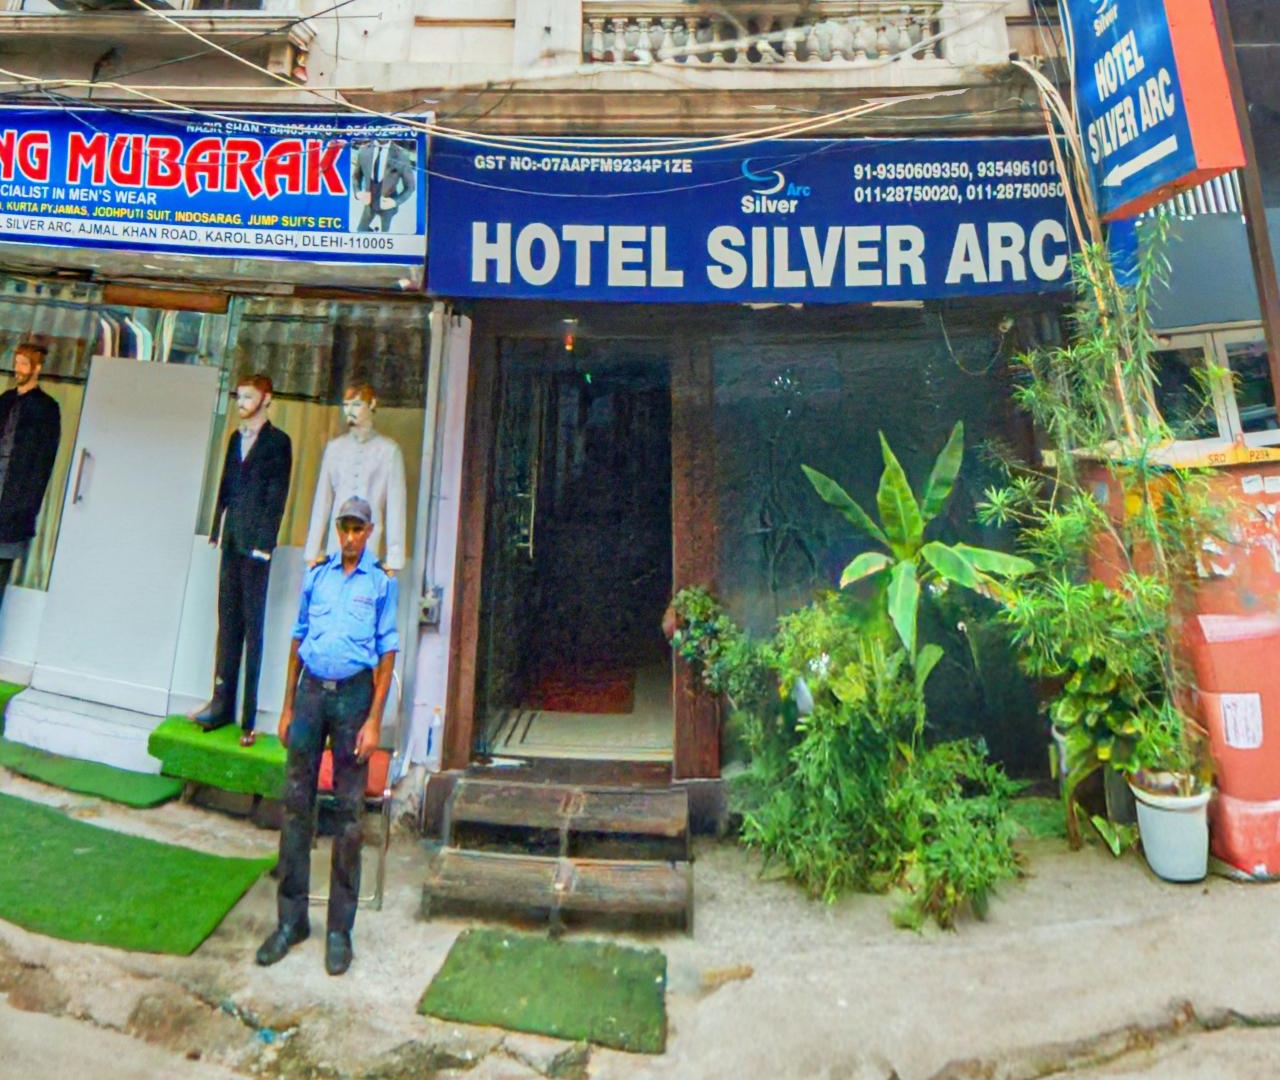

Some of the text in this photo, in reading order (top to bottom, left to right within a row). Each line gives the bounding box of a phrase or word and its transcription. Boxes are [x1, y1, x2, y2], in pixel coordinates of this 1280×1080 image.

[1093, 29, 1145, 102] HOTEL
[1087, 67, 1175, 164] SILVER ARC
[65, 129, 348, 201] MUBARAK
[474, 155, 506, 170] GST
[977, 160, 1063, 178] 935496101
[52, 186, 66, 200] IN
[68, 187, 111, 202] MEN'S
[114, 190, 157, 206] WEAR
[787, 182, 811, 197] Arc
[853, 182, 1065, 203] 011-28750020, 011-28750050
[5, 200, 39, 213] KURTA
[246, 214, 278, 227] JUMP
[281, 215, 315, 229] SUITS
[741, 195, 799, 214] Silver
[5, 218, 45, 231] SILVER
[77, 222, 119, 236] AJMAL
[121, 226, 157, 239] KHAN
[204, 230, 251, 245] KAROL
[254, 233, 298, 249] BAGH,
[301, 234, 395, 251] DLEHI-110005
[471, 219, 1070, 289] HOTEL SILVER ARC
